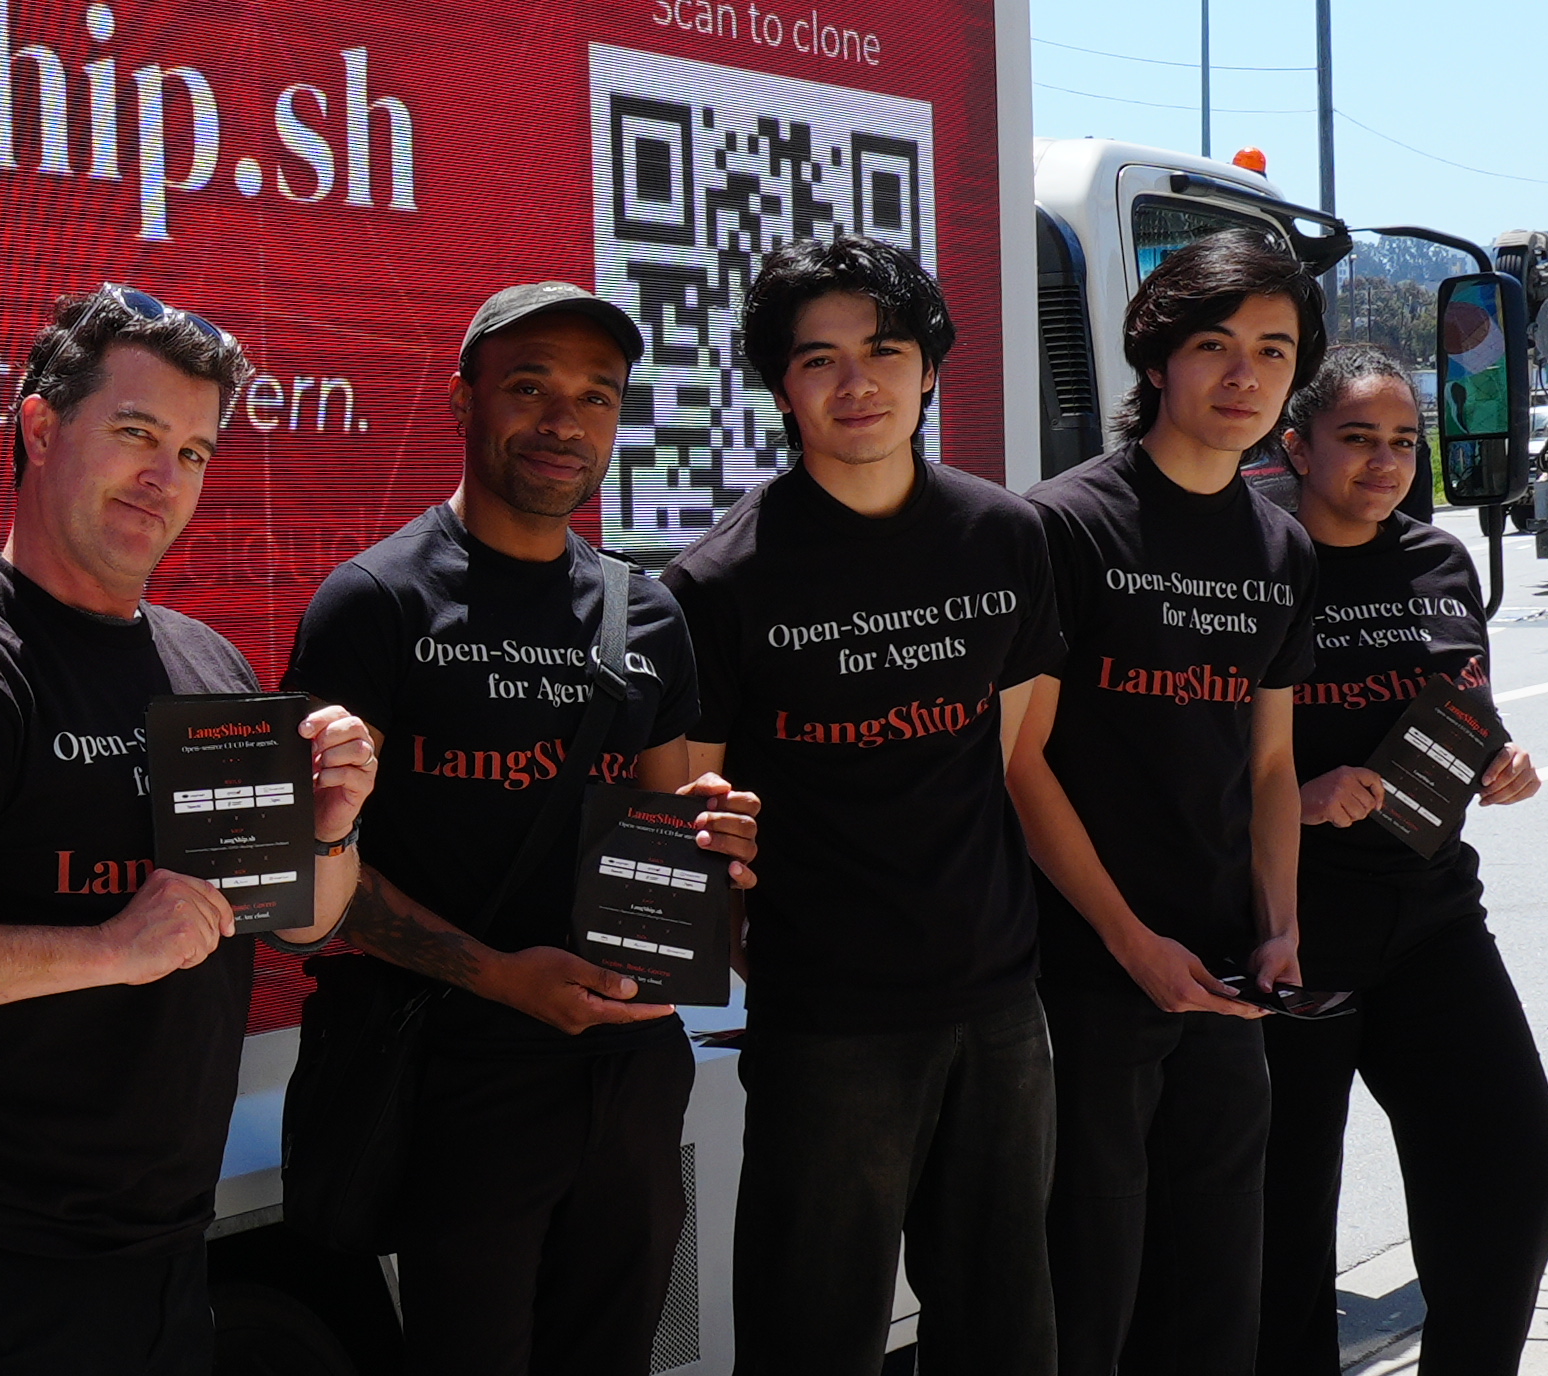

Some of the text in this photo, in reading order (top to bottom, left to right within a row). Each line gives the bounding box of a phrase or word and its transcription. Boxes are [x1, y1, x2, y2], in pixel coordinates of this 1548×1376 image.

[748, 2, 783, 47] to
[793, 10, 881, 66] clone
[1106, 568, 1294, 608] Open-Source CI/CD
[768, 589, 1018, 651] Open-Source CI/CD
[1162, 601, 1258, 635] for Agents
[1407, 597, 1468, 618] CI/CD
[1316, 625, 1432, 649] for Agents
[838, 635, 967, 675] for Agents
[488, 673, 529, 699] for
[187, 720, 271, 739] LangShip.sh
